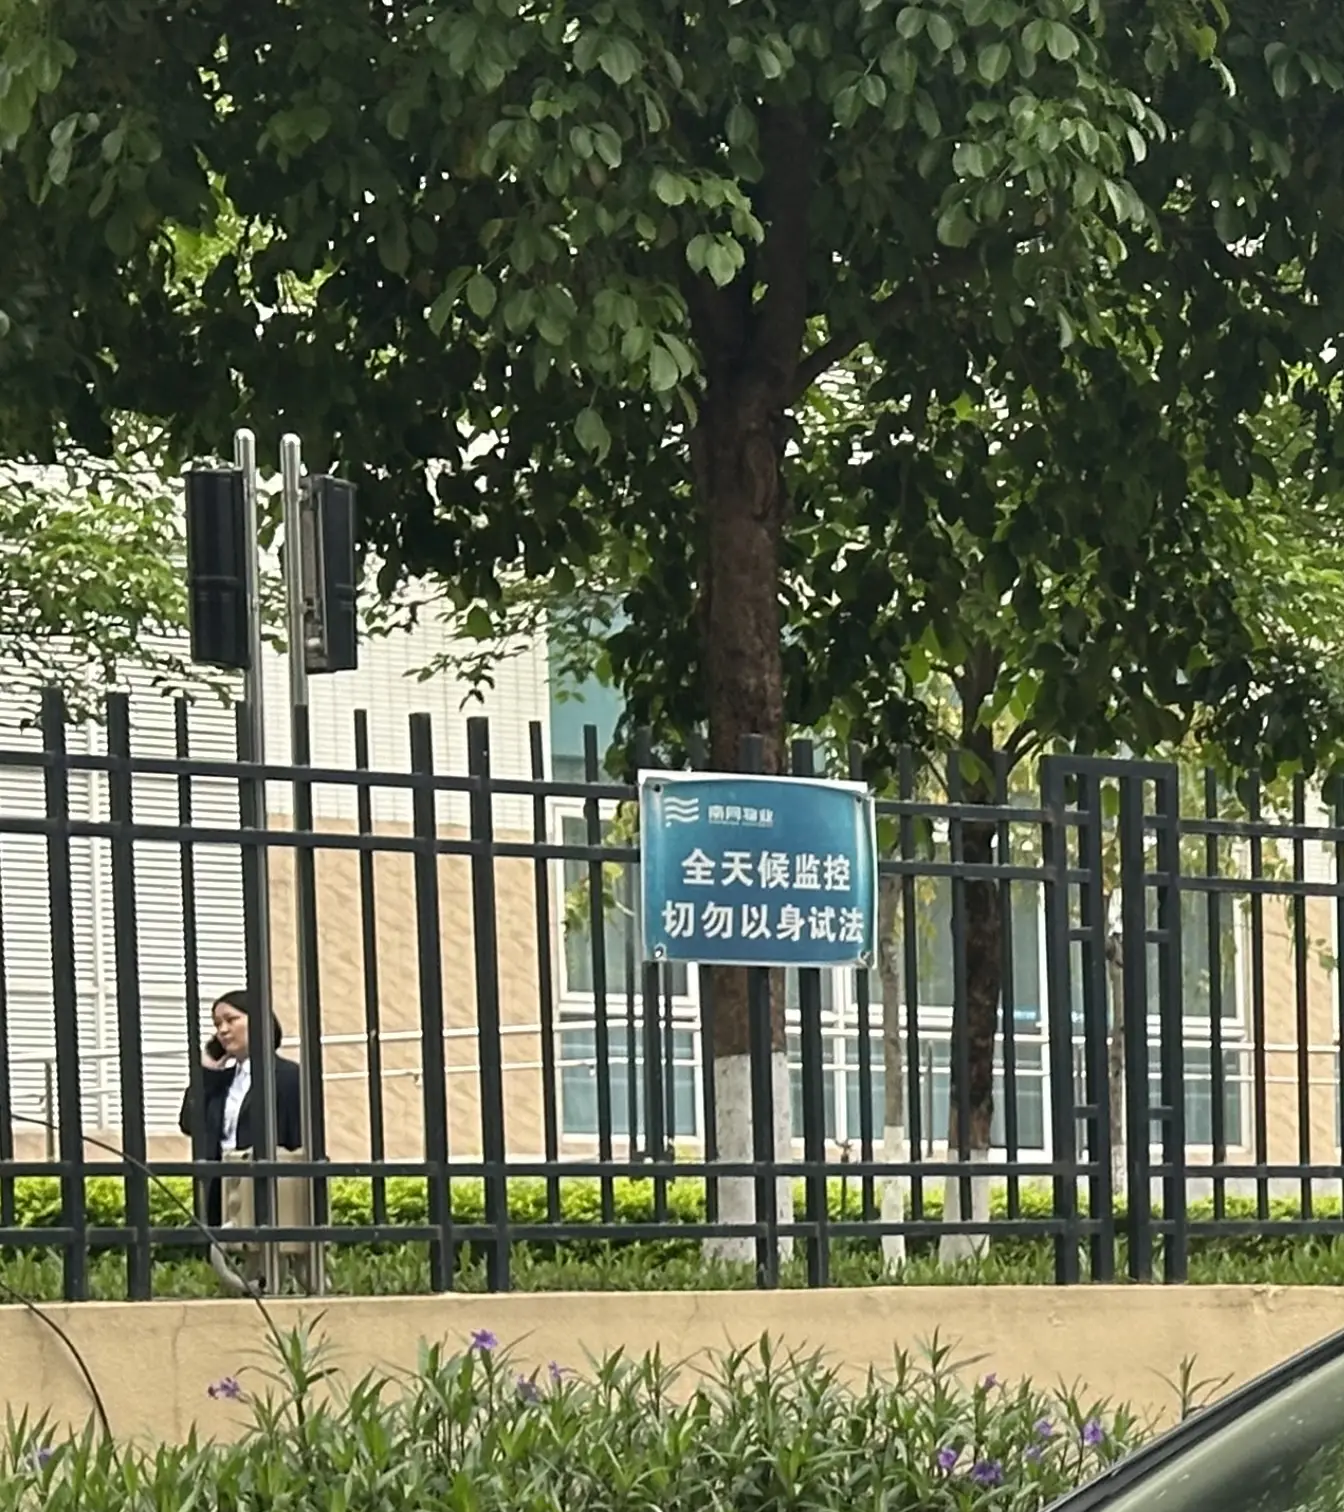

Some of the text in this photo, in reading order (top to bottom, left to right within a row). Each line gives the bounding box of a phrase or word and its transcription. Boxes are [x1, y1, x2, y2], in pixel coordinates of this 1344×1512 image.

[681, 848, 851, 891] 全天候监控
[661, 900, 865, 943] 切勿以身试法
